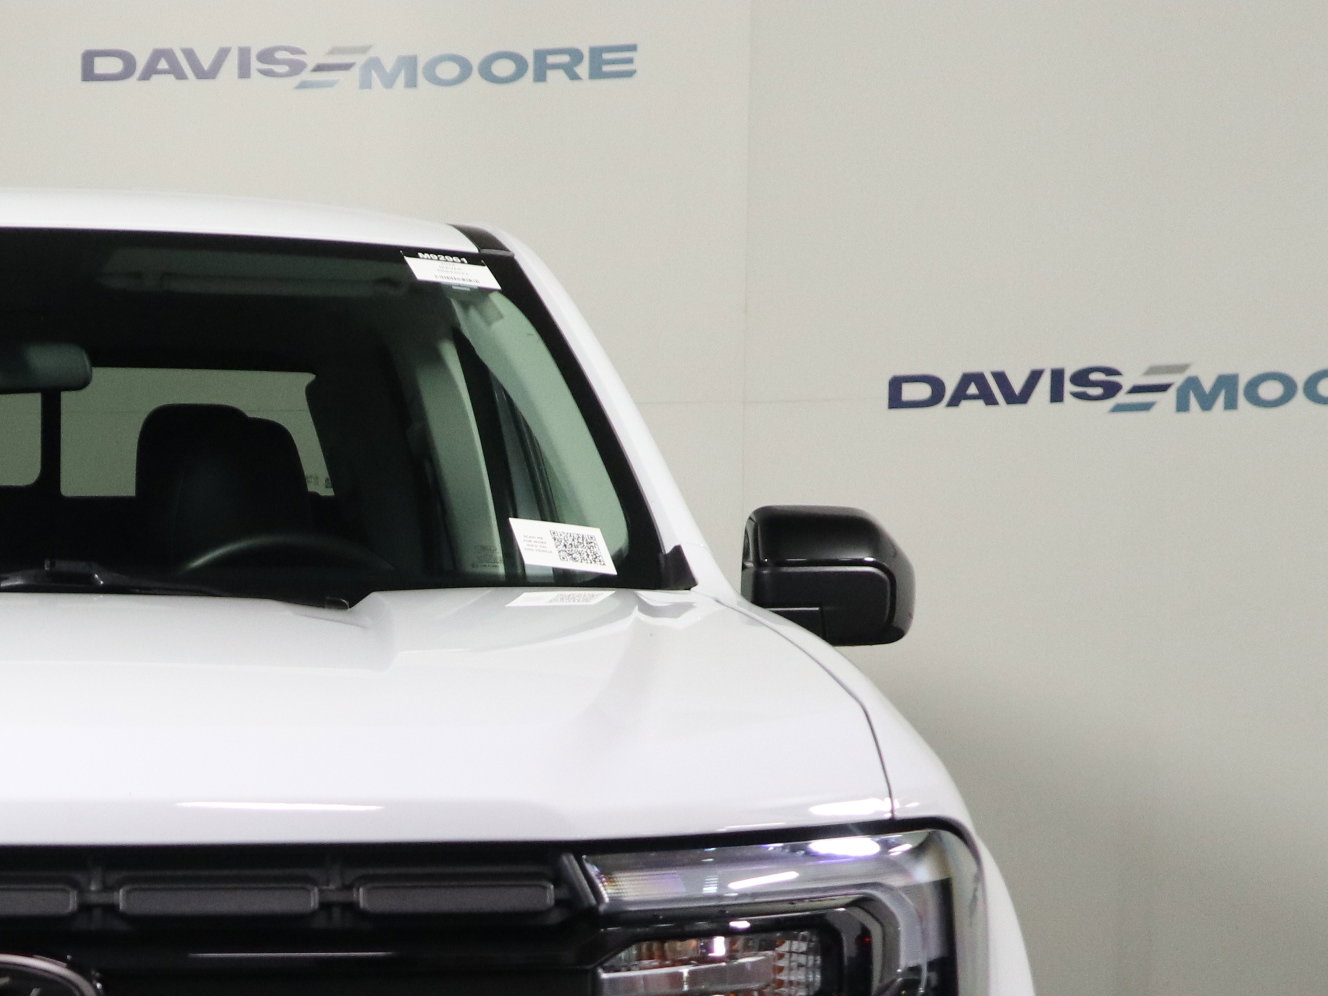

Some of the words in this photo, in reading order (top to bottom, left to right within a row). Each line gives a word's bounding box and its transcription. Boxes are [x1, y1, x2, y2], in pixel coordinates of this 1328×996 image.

[81, 45, 308, 82] DAVIS
[358, 44, 638, 90] MOORE
[887, 366, 1123, 410] DAVIS
